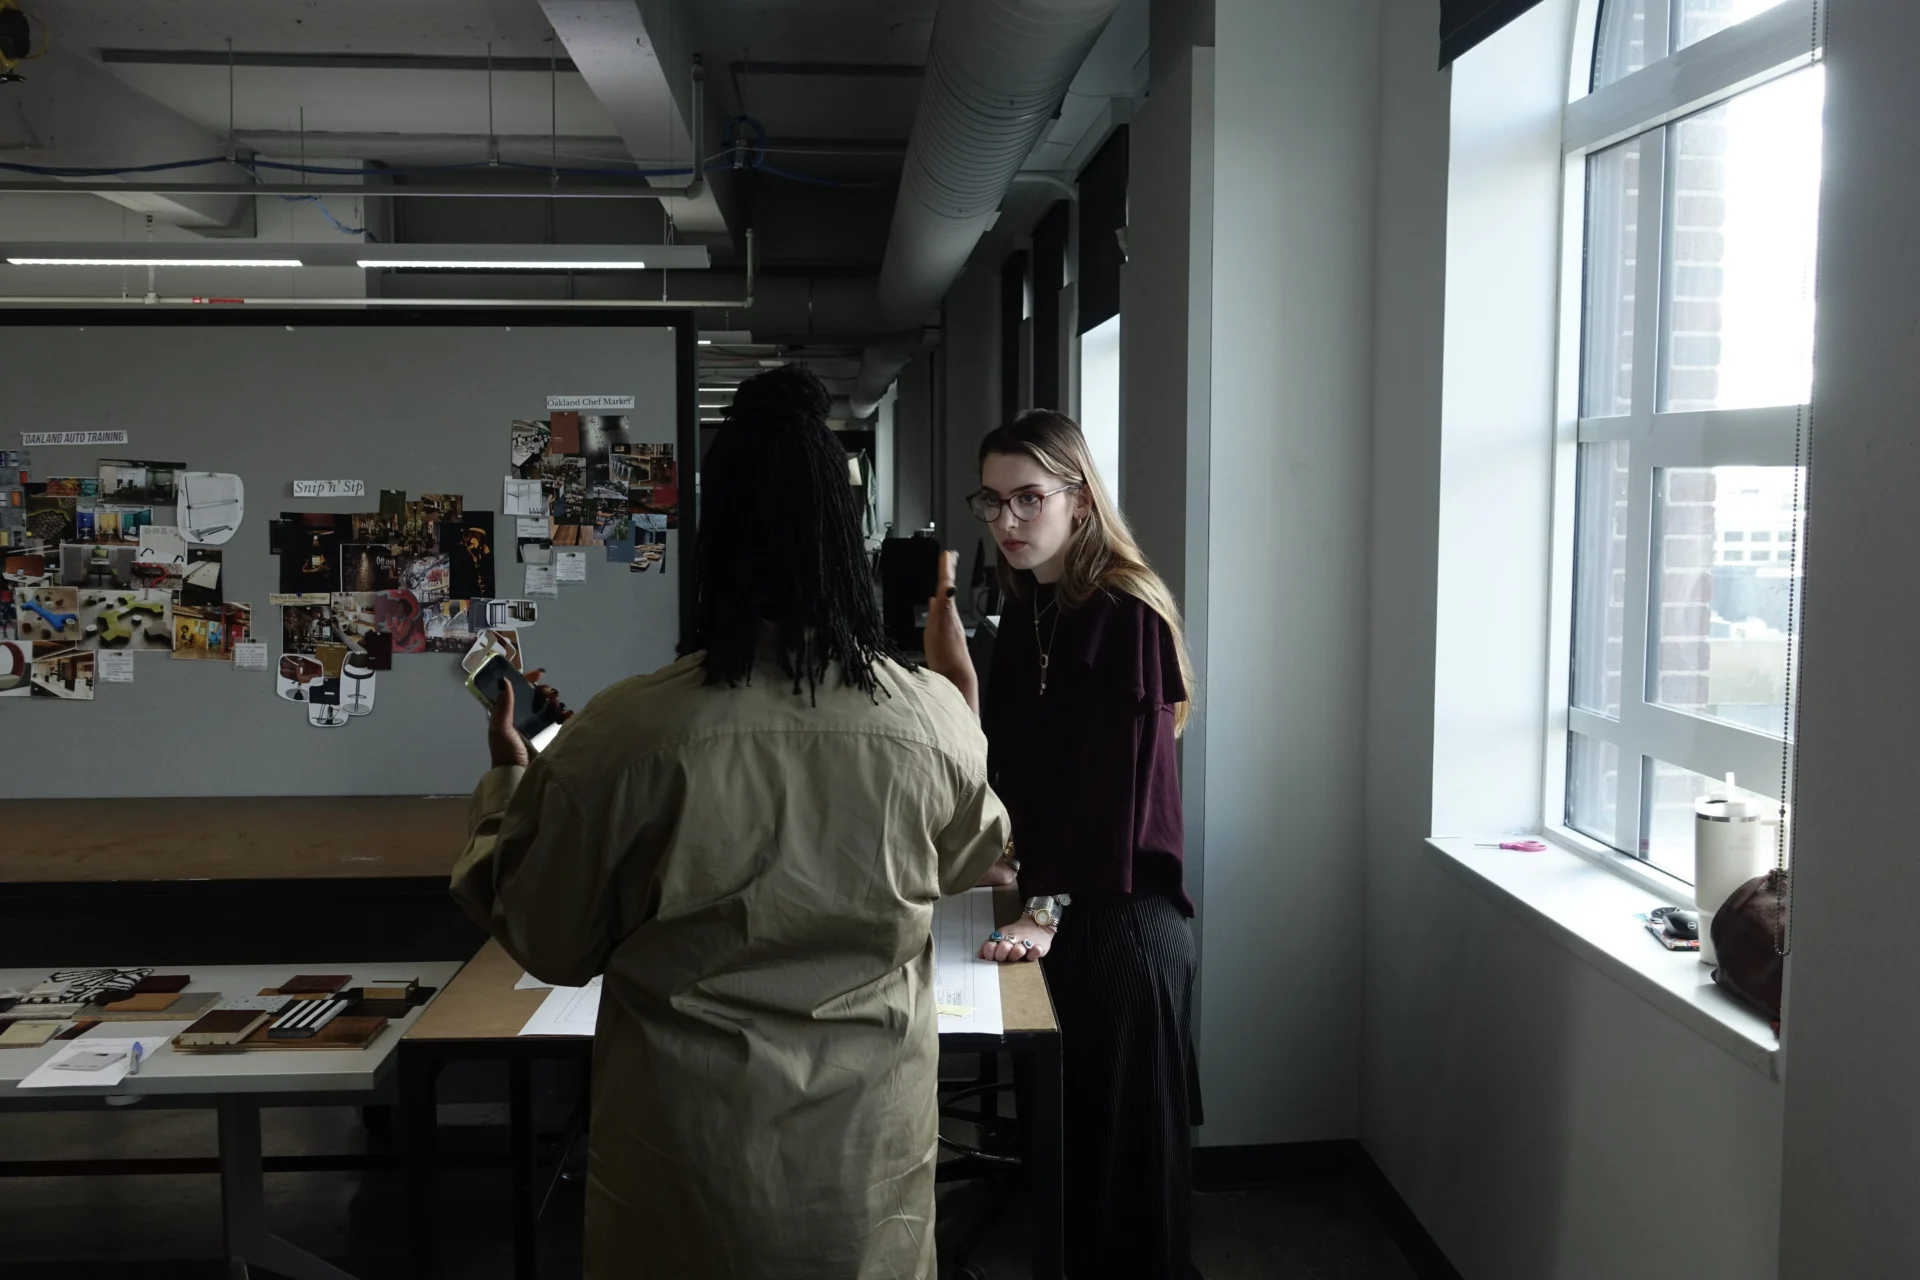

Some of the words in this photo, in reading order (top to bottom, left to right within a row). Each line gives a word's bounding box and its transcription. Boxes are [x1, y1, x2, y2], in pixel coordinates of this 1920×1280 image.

[547, 398, 580, 407] Oakland
[582, 398, 602, 406] Chef
[603, 397, 631, 405] Market
[25, 433, 62, 444] OAKLAND
[63, 432, 86, 443] AUTO
[87, 431, 125, 442] TRAINING
[295, 481, 325, 496] Snip
[343, 480, 363, 496] Sip
